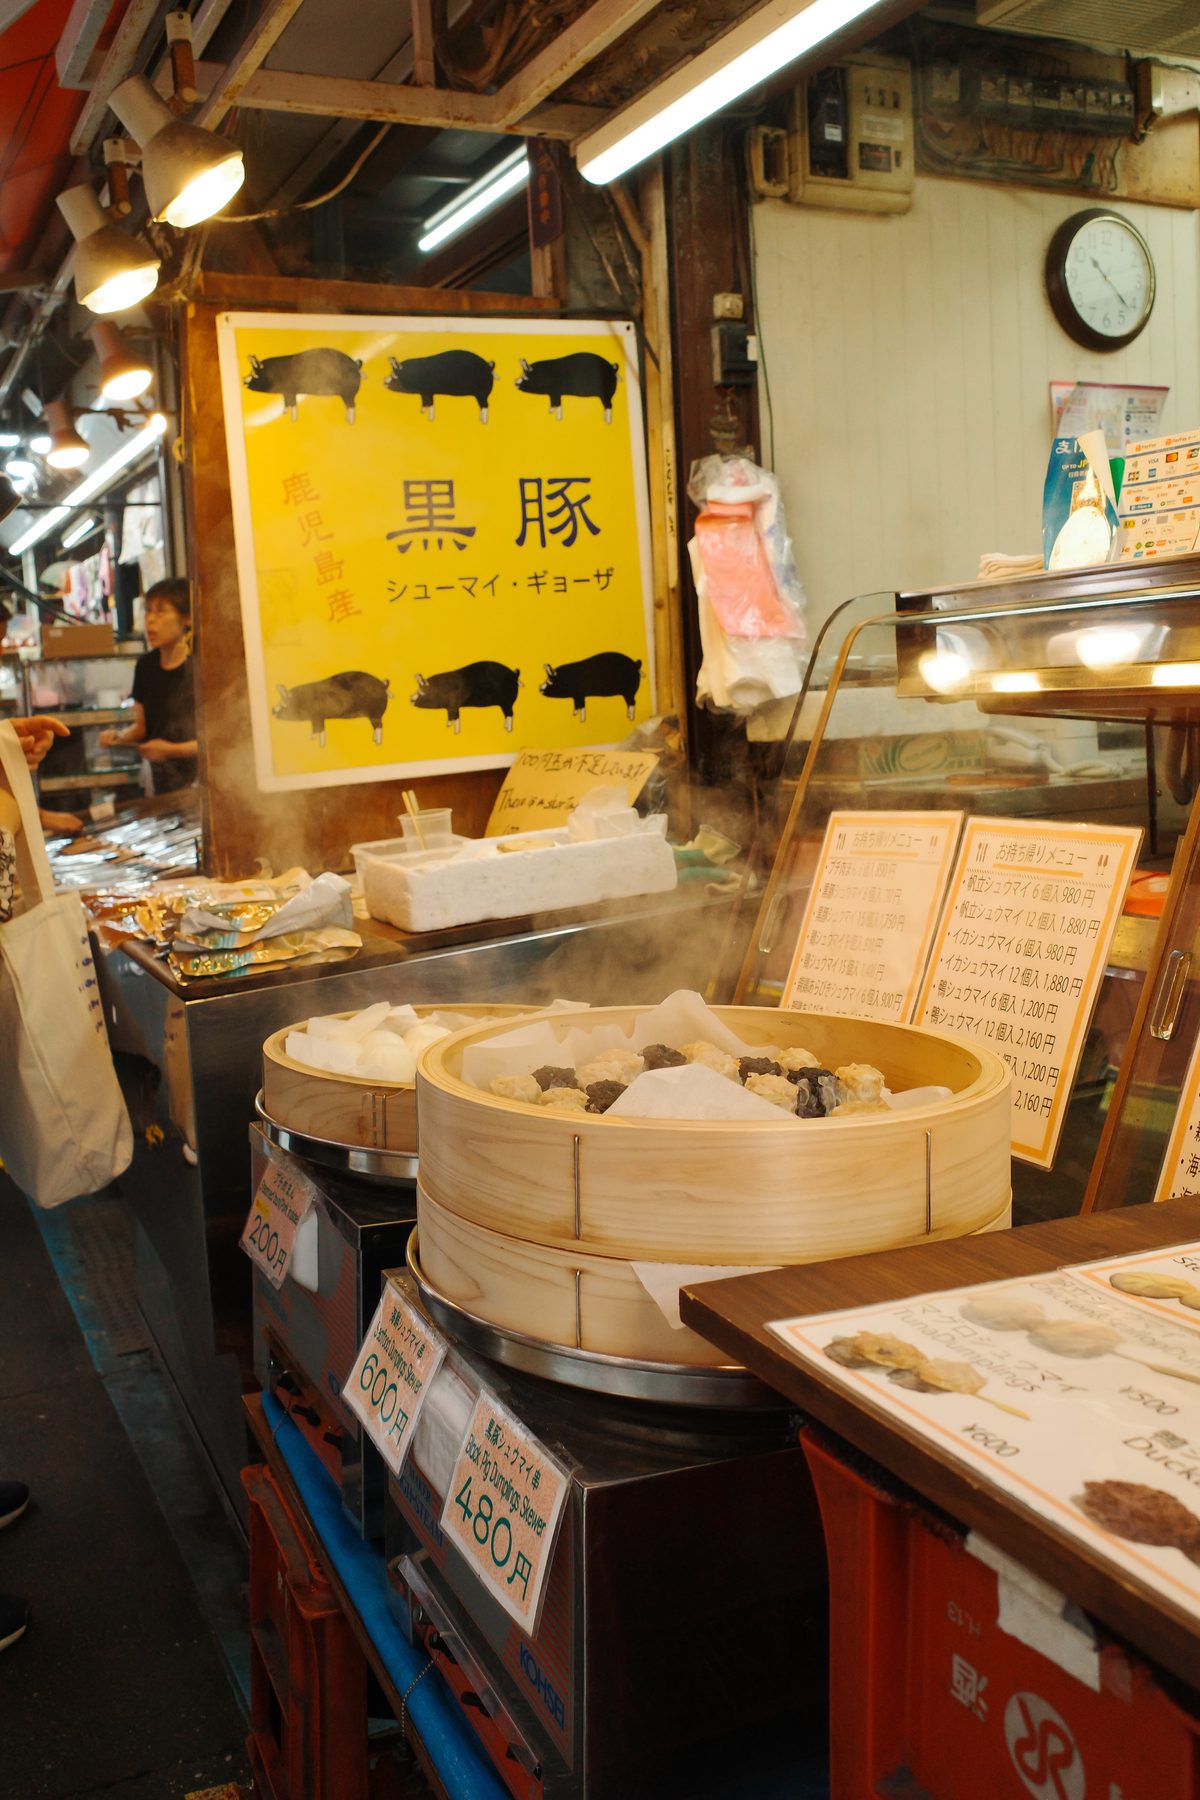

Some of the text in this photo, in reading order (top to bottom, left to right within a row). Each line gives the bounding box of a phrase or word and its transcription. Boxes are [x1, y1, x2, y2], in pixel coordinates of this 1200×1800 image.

[1102, 230, 1112, 246] 12
[1103, 312, 1111, 329] 6
[1118, 310, 1126, 325] 5
[281, 471, 362, 624] 鹿児島産
[388, 567, 615, 604] シューマイ・ギョーザ
[996, 841, 1088, 867] お持ち帰りメニュー
[921, 1303, 1089, 1393] マグロシュウマイ
[1118, 1384, 1181, 1417] ¥500
[484, 1417, 542, 1491] 黒豚シュウマイ串
[960, 1422, 1021, 1459] ¥600
[465, 1432, 548, 1538] Black Pig Dumplings Skewer
[519, 1641, 566, 1731] KOHSEI
